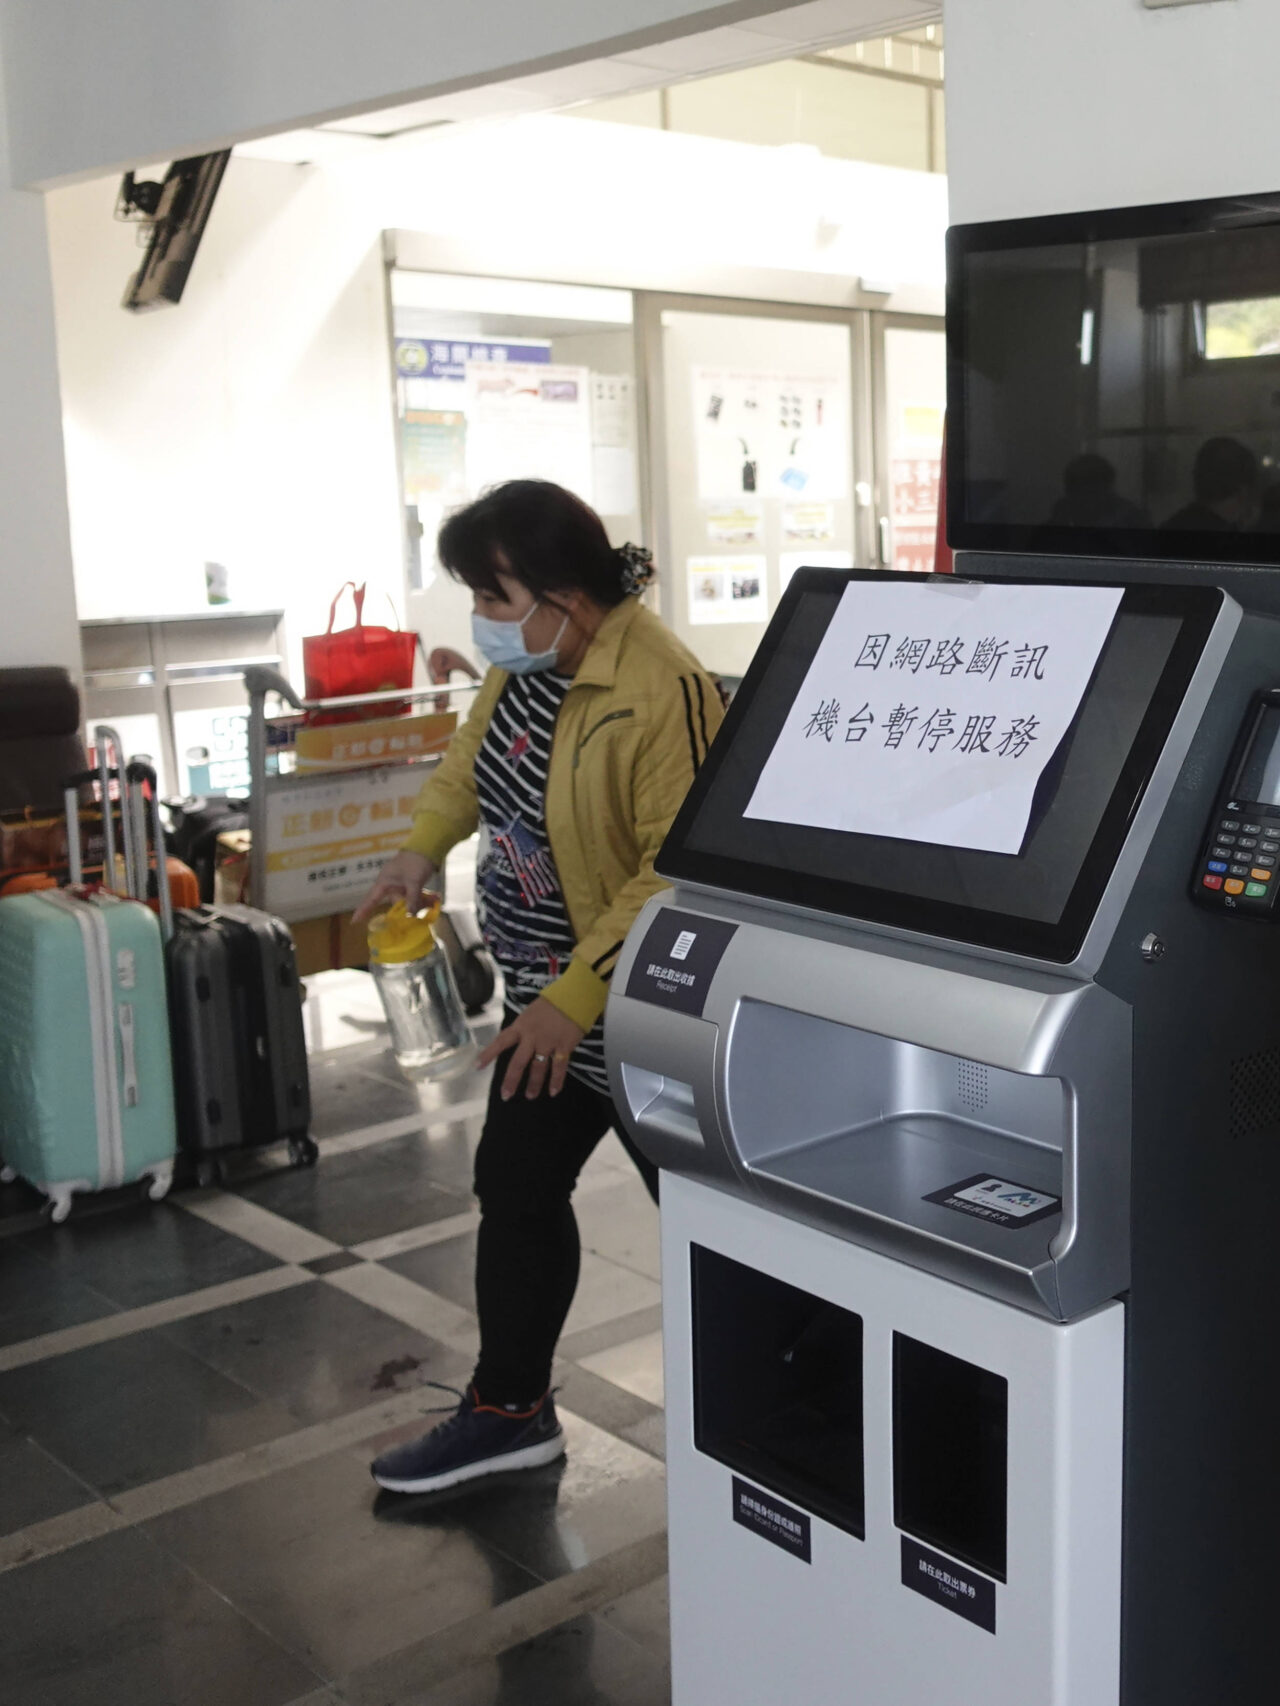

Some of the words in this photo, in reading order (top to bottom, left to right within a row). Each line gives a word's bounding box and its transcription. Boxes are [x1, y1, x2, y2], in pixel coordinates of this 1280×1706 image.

[853, 632, 1049, 683] 因網路斷訊
[803, 698, 1042, 760] 機台暫停服務
